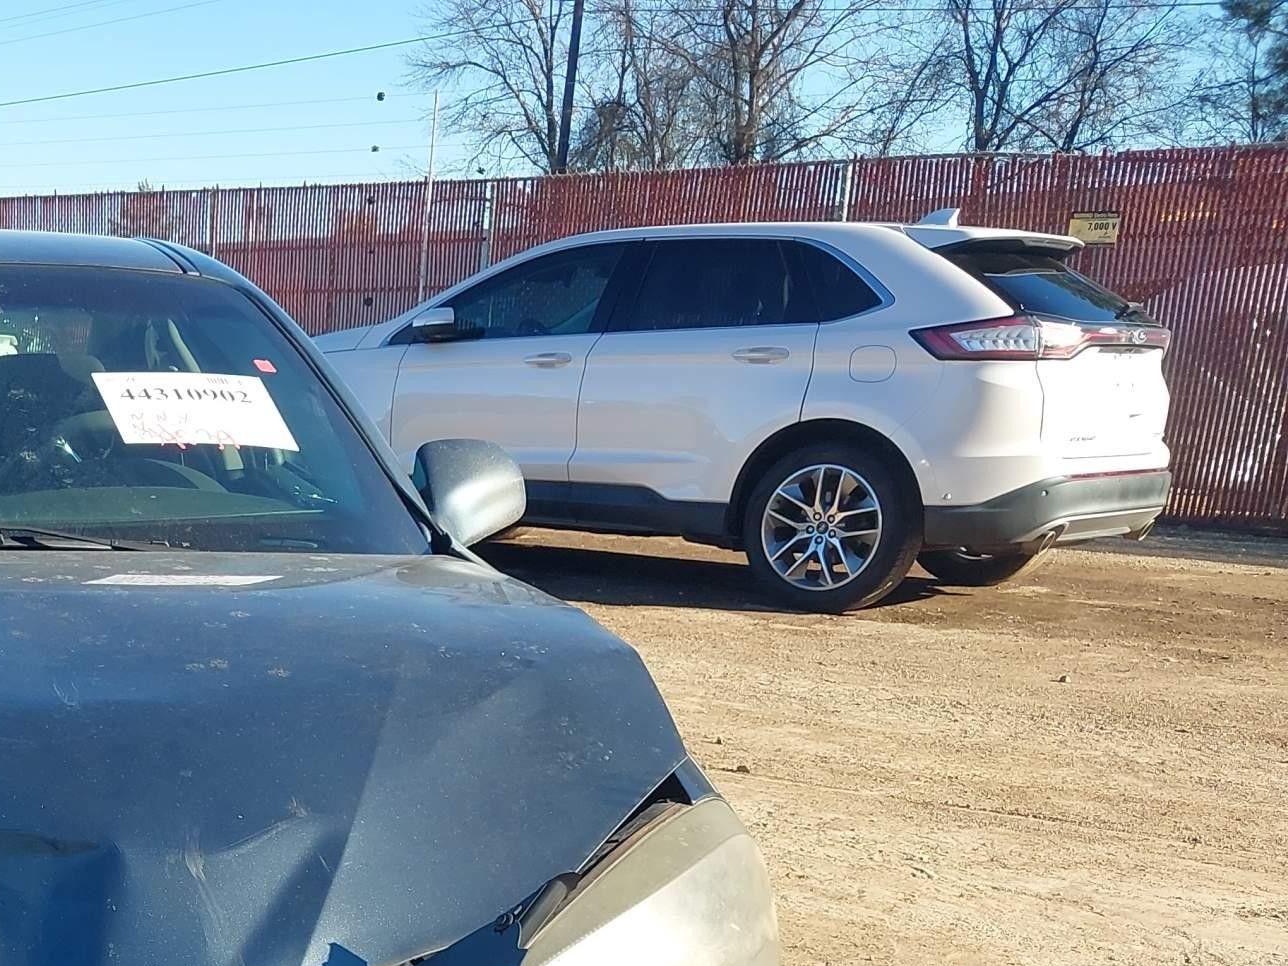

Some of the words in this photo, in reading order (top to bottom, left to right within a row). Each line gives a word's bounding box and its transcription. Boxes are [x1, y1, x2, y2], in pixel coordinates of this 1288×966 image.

[1087, 222, 1109, 232] 7,000
[1112, 222, 1118, 230] V
[120, 387, 253, 403] 44310902
